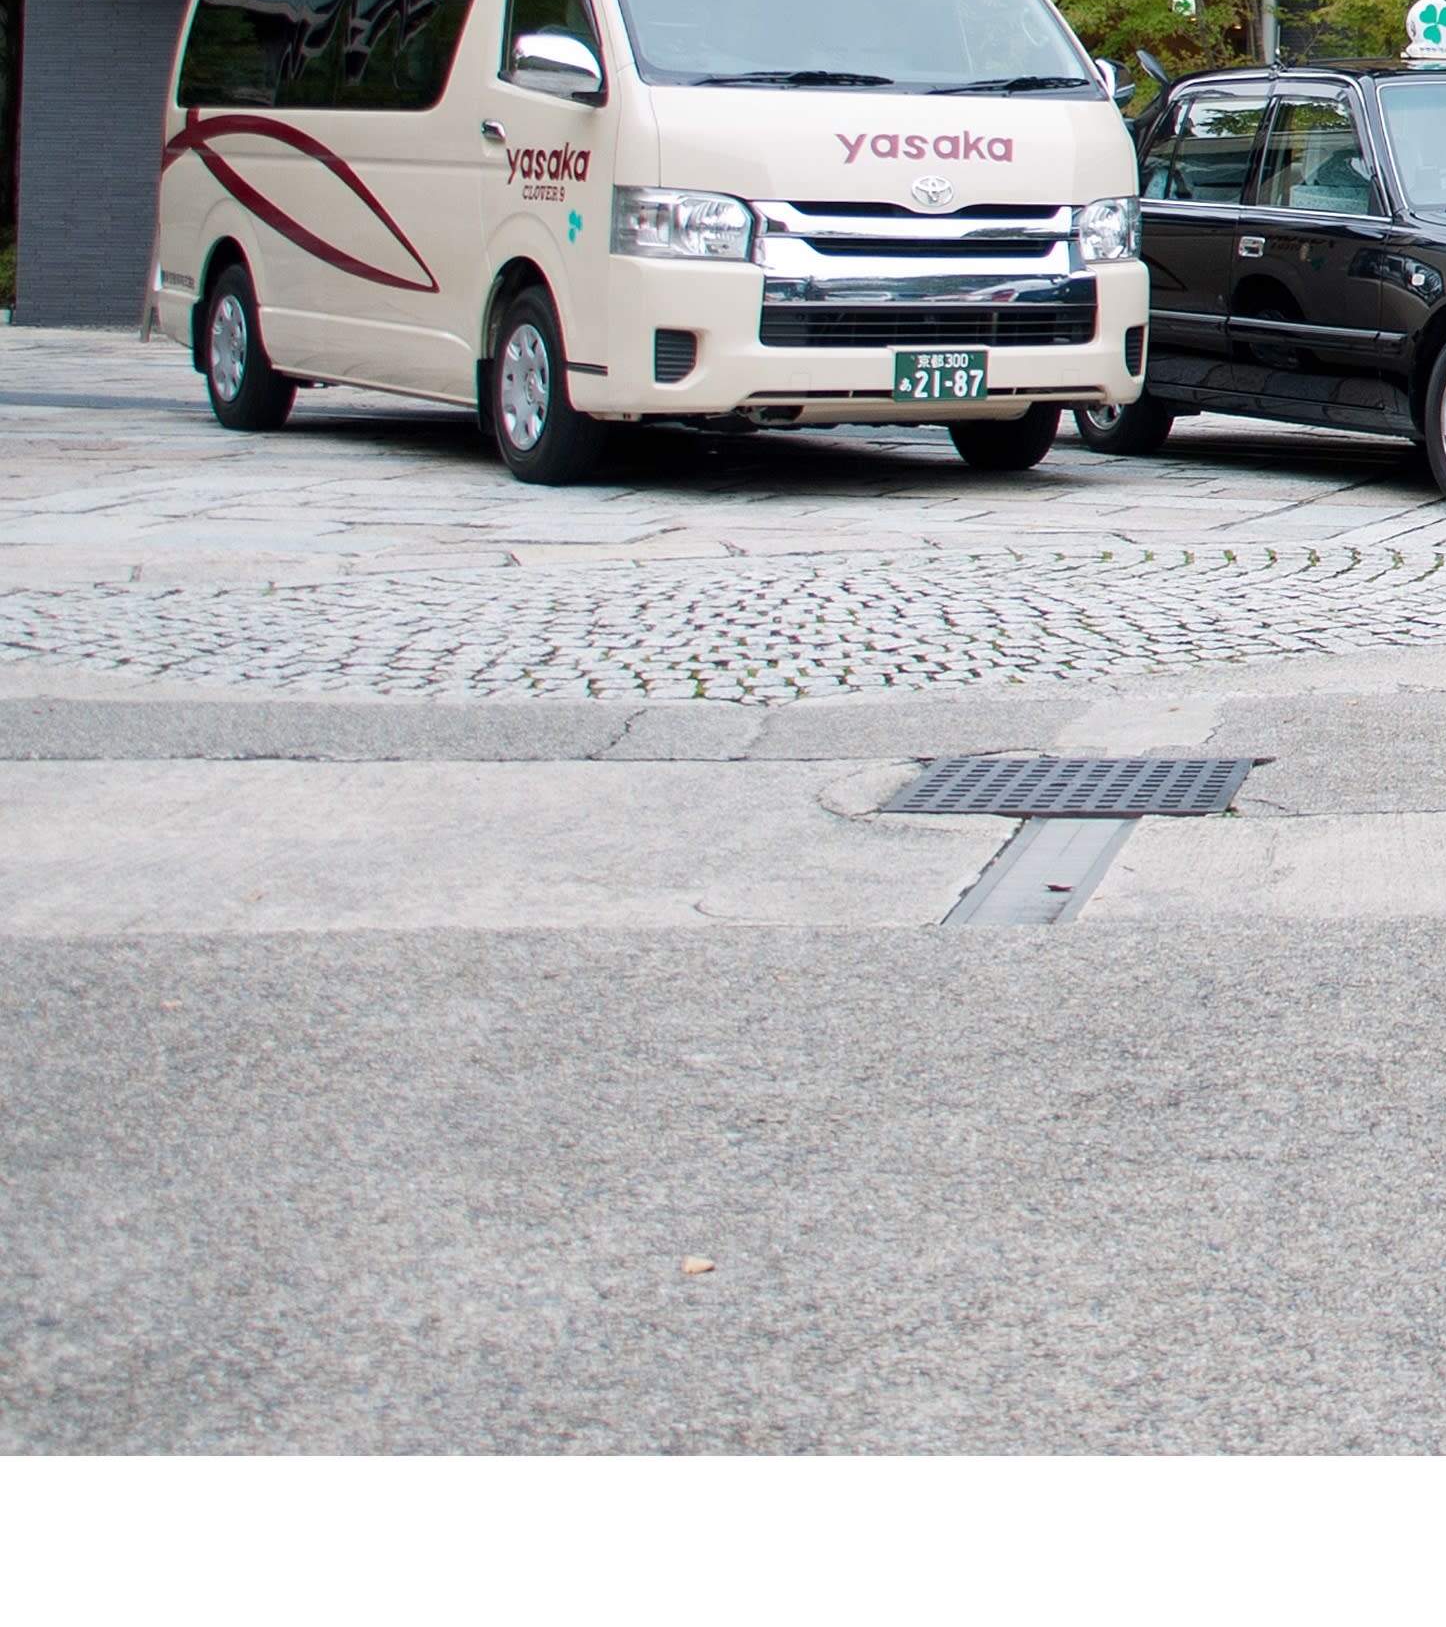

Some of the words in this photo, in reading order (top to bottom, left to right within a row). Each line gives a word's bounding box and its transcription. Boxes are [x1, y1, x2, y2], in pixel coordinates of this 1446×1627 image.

[506, 141, 591, 185] yasaka
[835, 130, 1014, 164] yasaka
[899, 377, 912, 392] あ
[914, 369, 984, 398] 21-87
